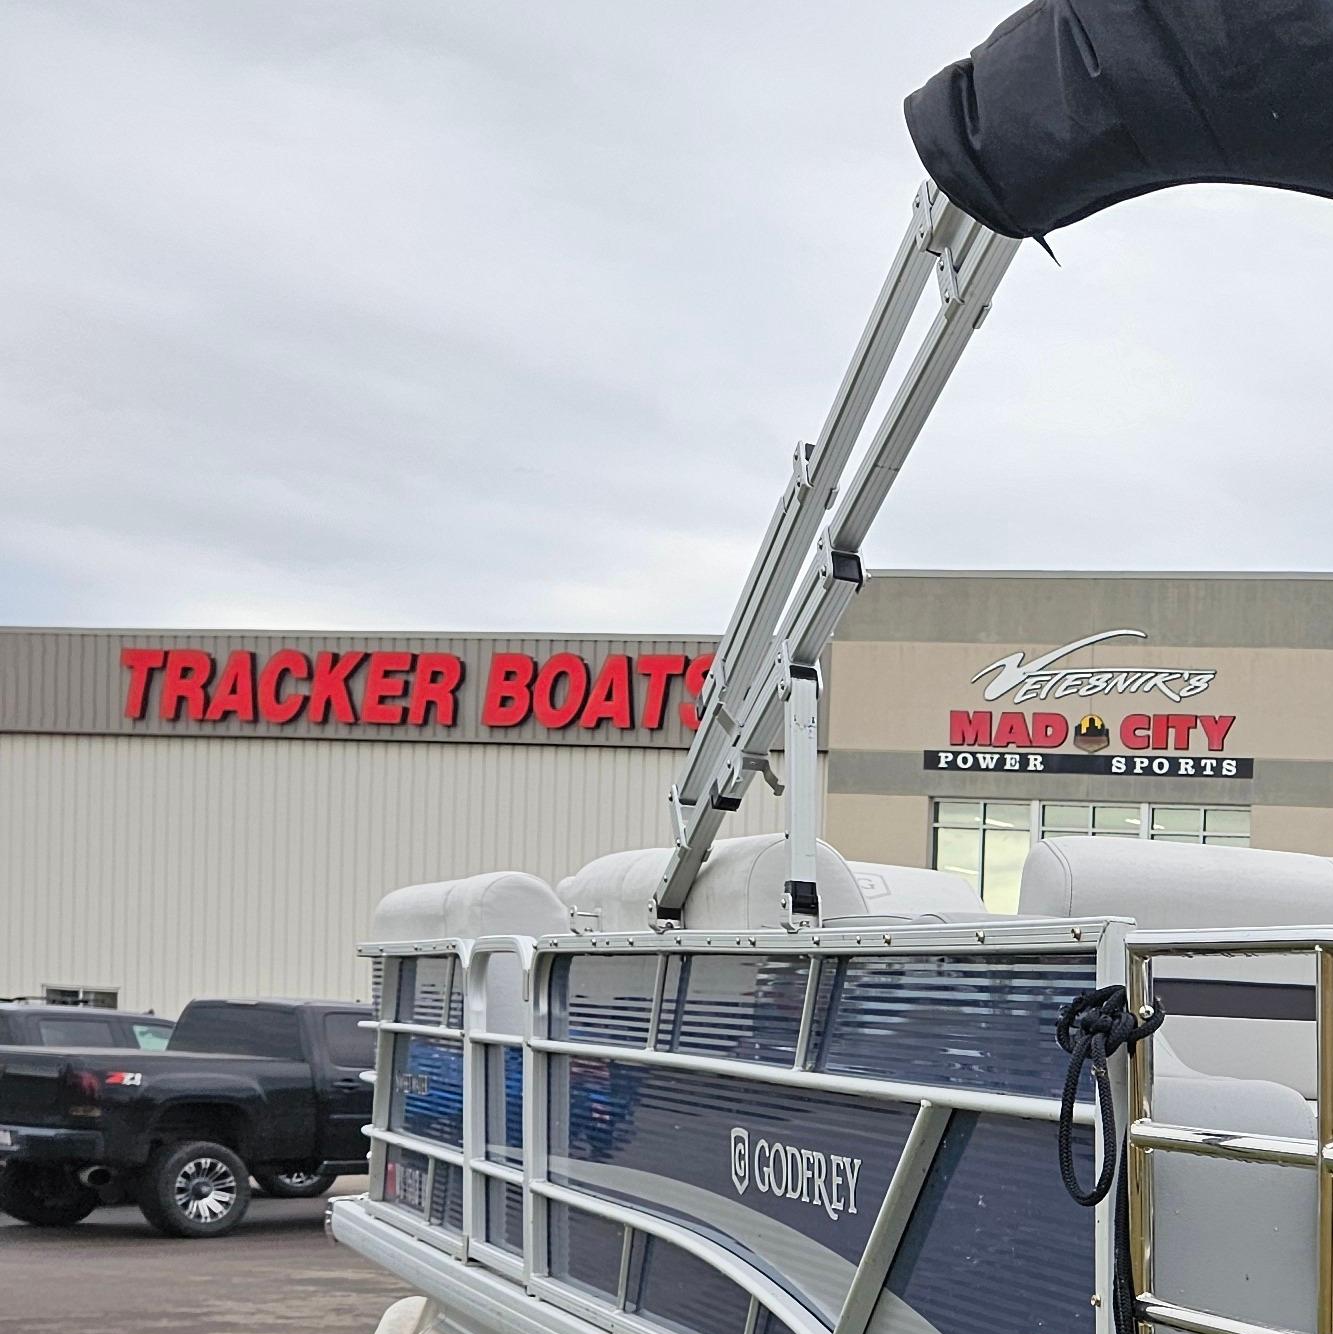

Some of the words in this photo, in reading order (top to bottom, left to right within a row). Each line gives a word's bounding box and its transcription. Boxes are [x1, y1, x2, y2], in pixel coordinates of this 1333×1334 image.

[121, 649, 461, 726] TRACKER
[949, 710, 1069, 748] MAD
[1119, 713, 1236, 751] CITY
[938, 752, 1045, 772] POWER
[1111, 757, 1237, 776] SPORTS
[755, 1138, 862, 1220] GODFREY
